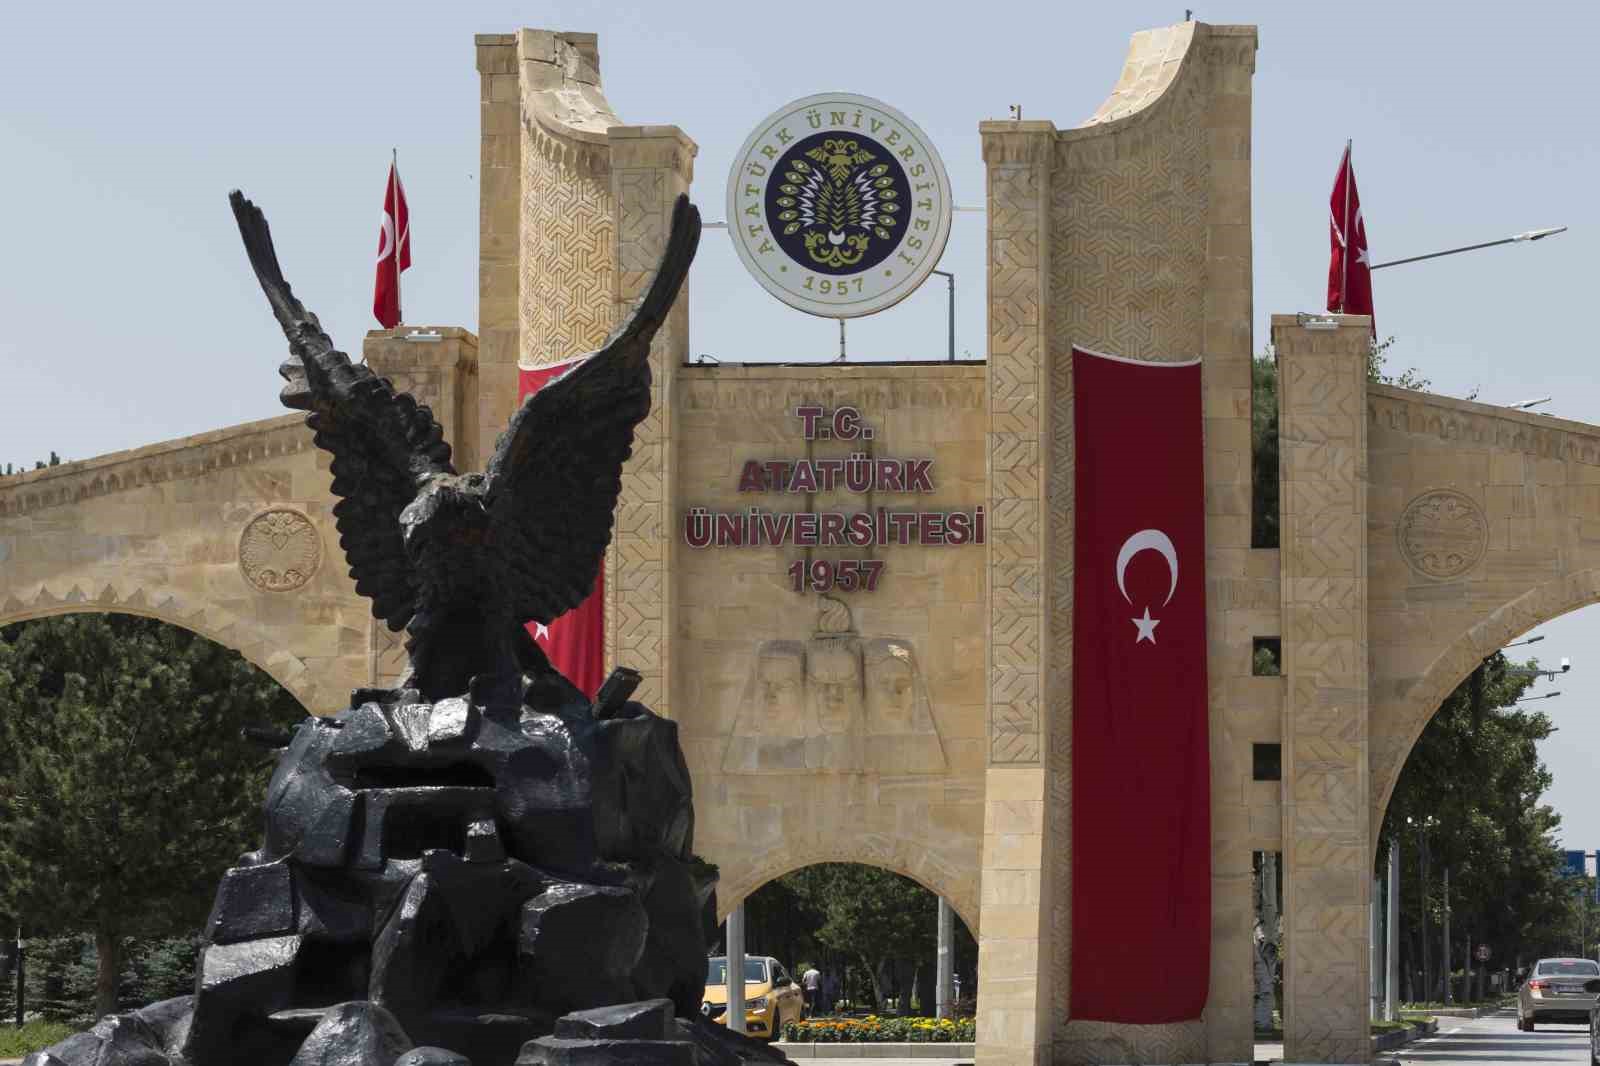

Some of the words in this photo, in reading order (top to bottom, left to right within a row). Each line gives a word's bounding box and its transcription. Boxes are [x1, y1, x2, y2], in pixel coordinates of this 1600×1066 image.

[744, 127, 795, 255] ATATÜRK
[806, 109, 935, 266] ÜNİVERSİTESİ
[803, 276, 865, 296] 1957
[796, 406, 874, 440] T.C.
[737, 452, 935, 492] ATATÜRK
[684, 506, 985, 548] ÜNİVERSİTESİ
[788, 559, 885, 592] 1957
